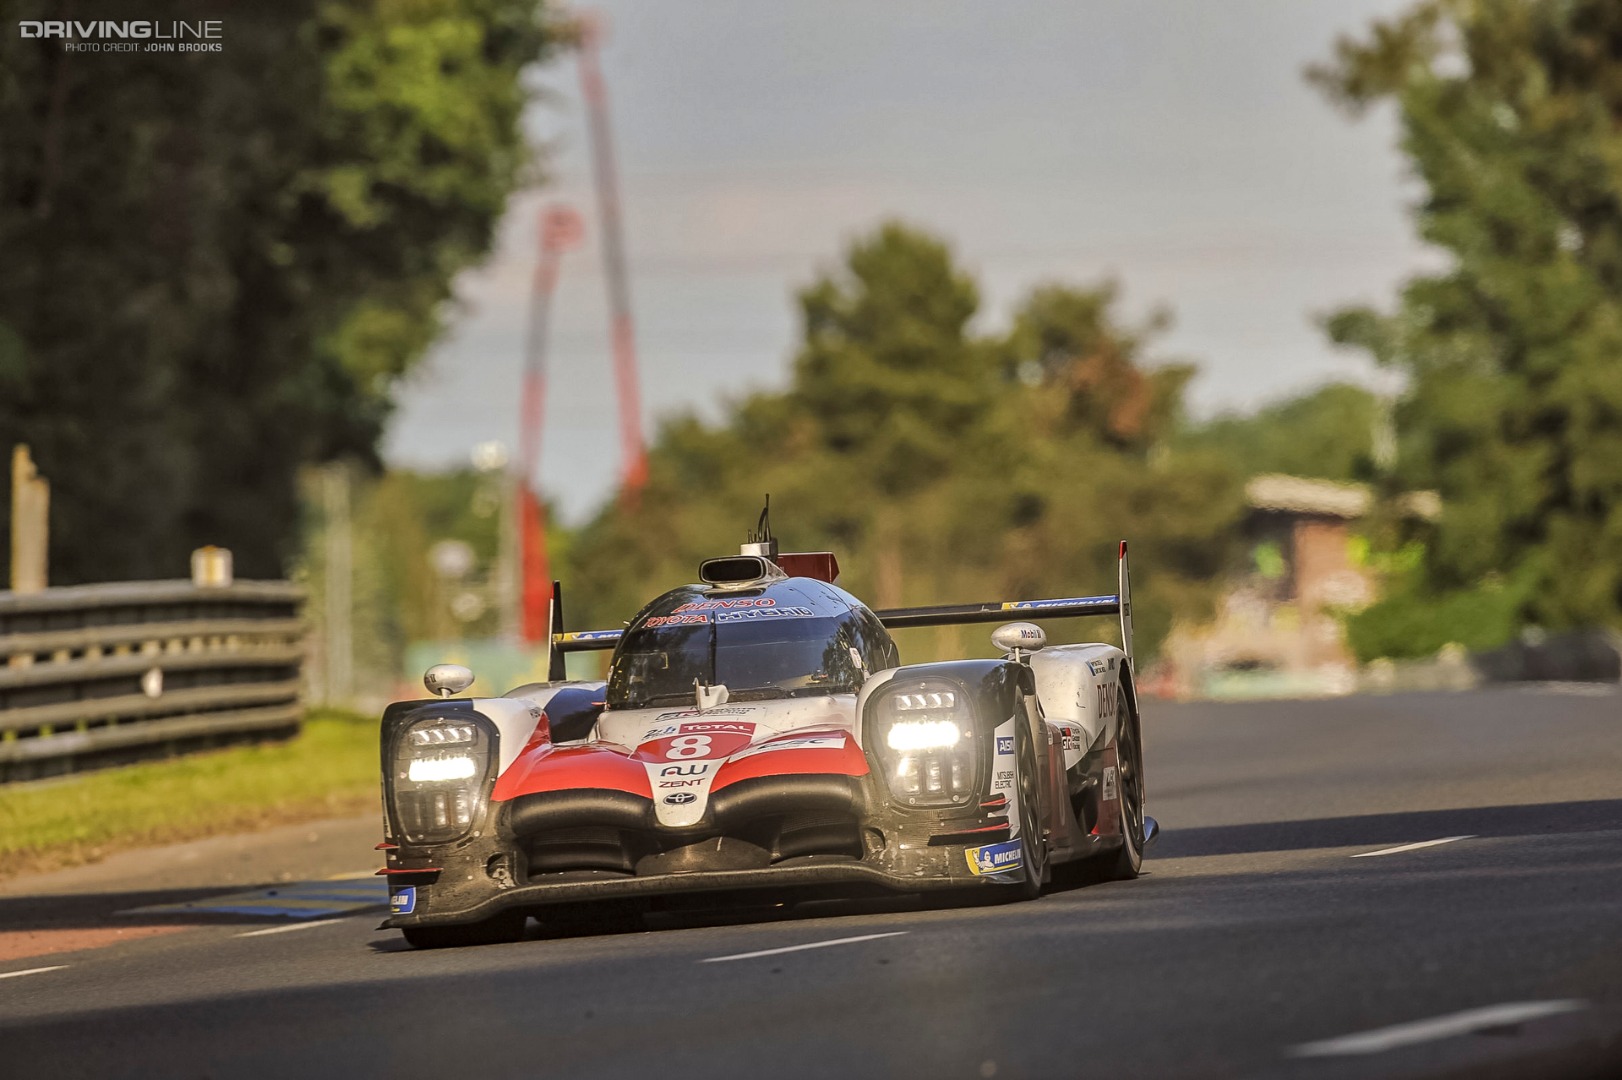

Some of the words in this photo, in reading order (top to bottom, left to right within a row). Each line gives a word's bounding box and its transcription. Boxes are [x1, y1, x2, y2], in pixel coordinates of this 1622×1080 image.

[671, 598, 776, 614] DENSO
[642, 614, 709, 629] TOYOTA
[717, 606, 815, 622] HYBRID
[683, 723, 752, 732] TOTAL
[665, 734, 713, 760] 8
[658, 777, 706, 788] ZENT
[994, 848, 1021, 865] MICHELIN
